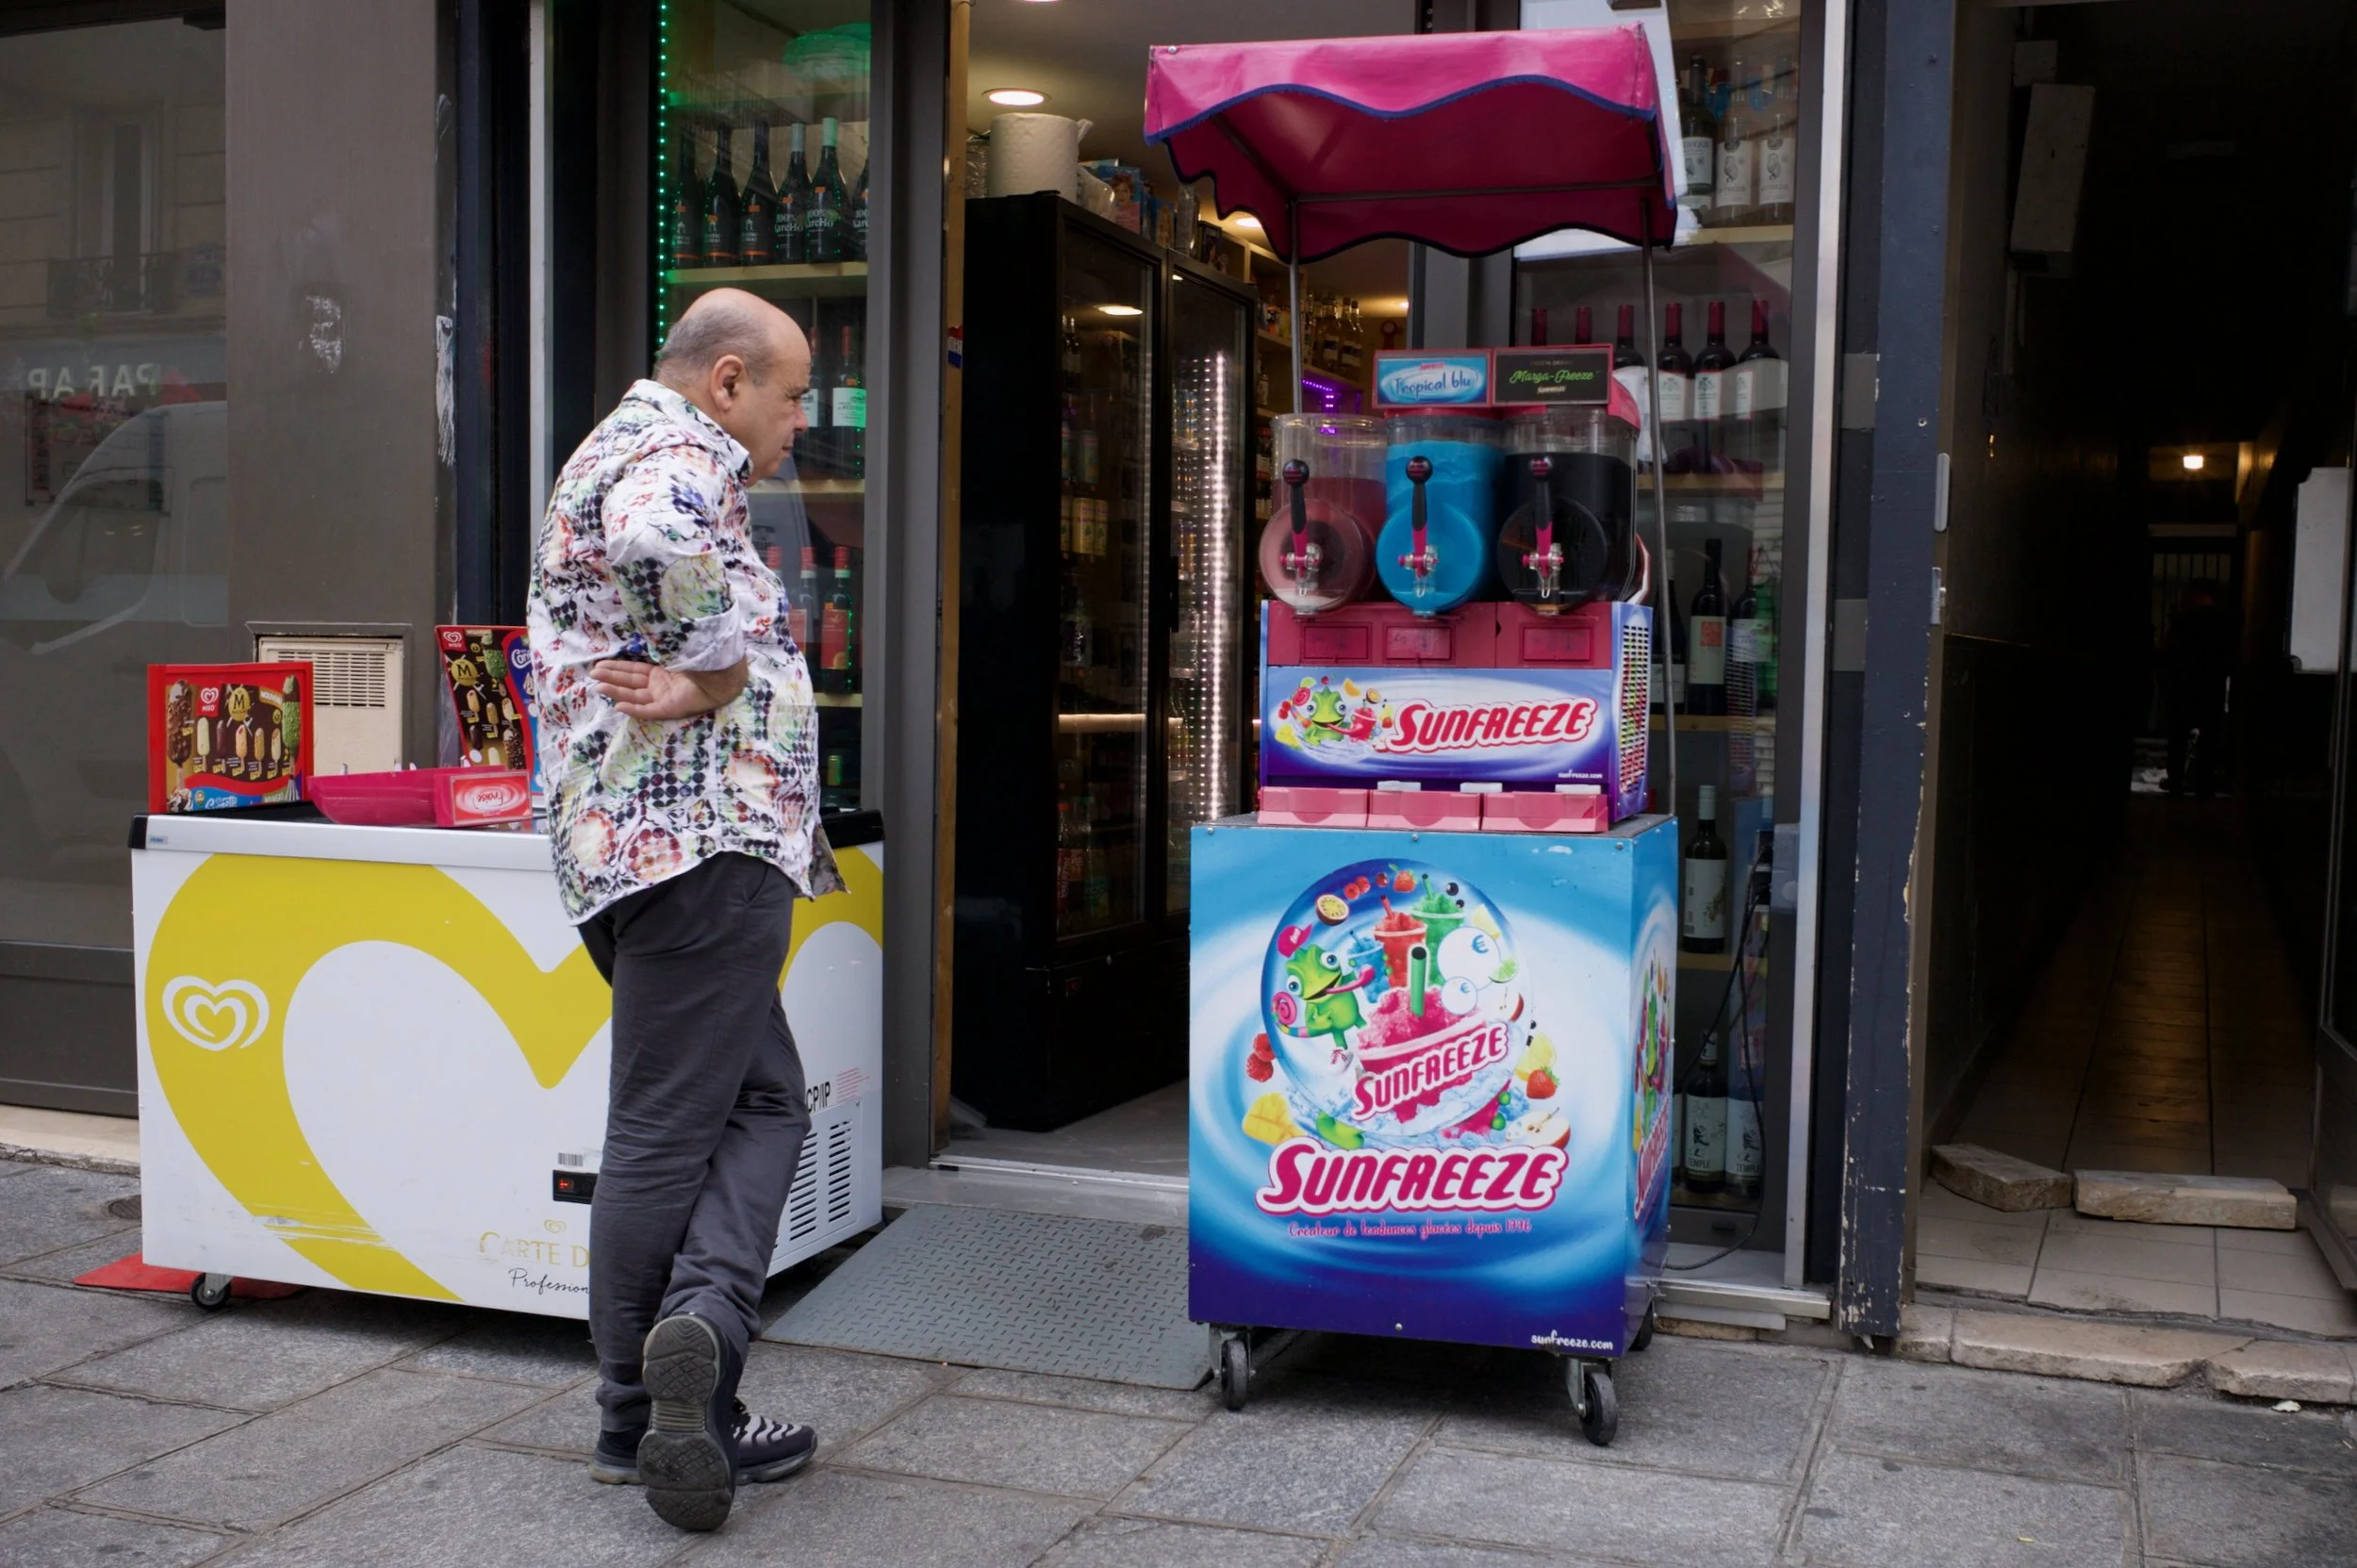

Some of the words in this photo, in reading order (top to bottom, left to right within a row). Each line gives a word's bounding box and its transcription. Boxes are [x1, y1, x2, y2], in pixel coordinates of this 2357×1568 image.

[1394, 371, 1446, 397] Tropical
[1451, 371, 1471, 388] blu
[1390, 701, 1591, 747] SUNFREEZE
[1558, 768, 1603, 780] sunfreeze.com
[1354, 1025, 1505, 1116] SUNFREEZE
[1262, 1143, 1559, 1206] SUNFREEZE
[1688, 1157, 1711, 1169] TEMPLE
[1289, 1221, 1339, 1237] Créateur
[1343, 1220, 1357, 1237] de
[1466, 1218, 1502, 1239] depuis
[1506, 1217, 1532, 1232] 1996
[1531, 1329, 1614, 1350] sunfreeze.com
